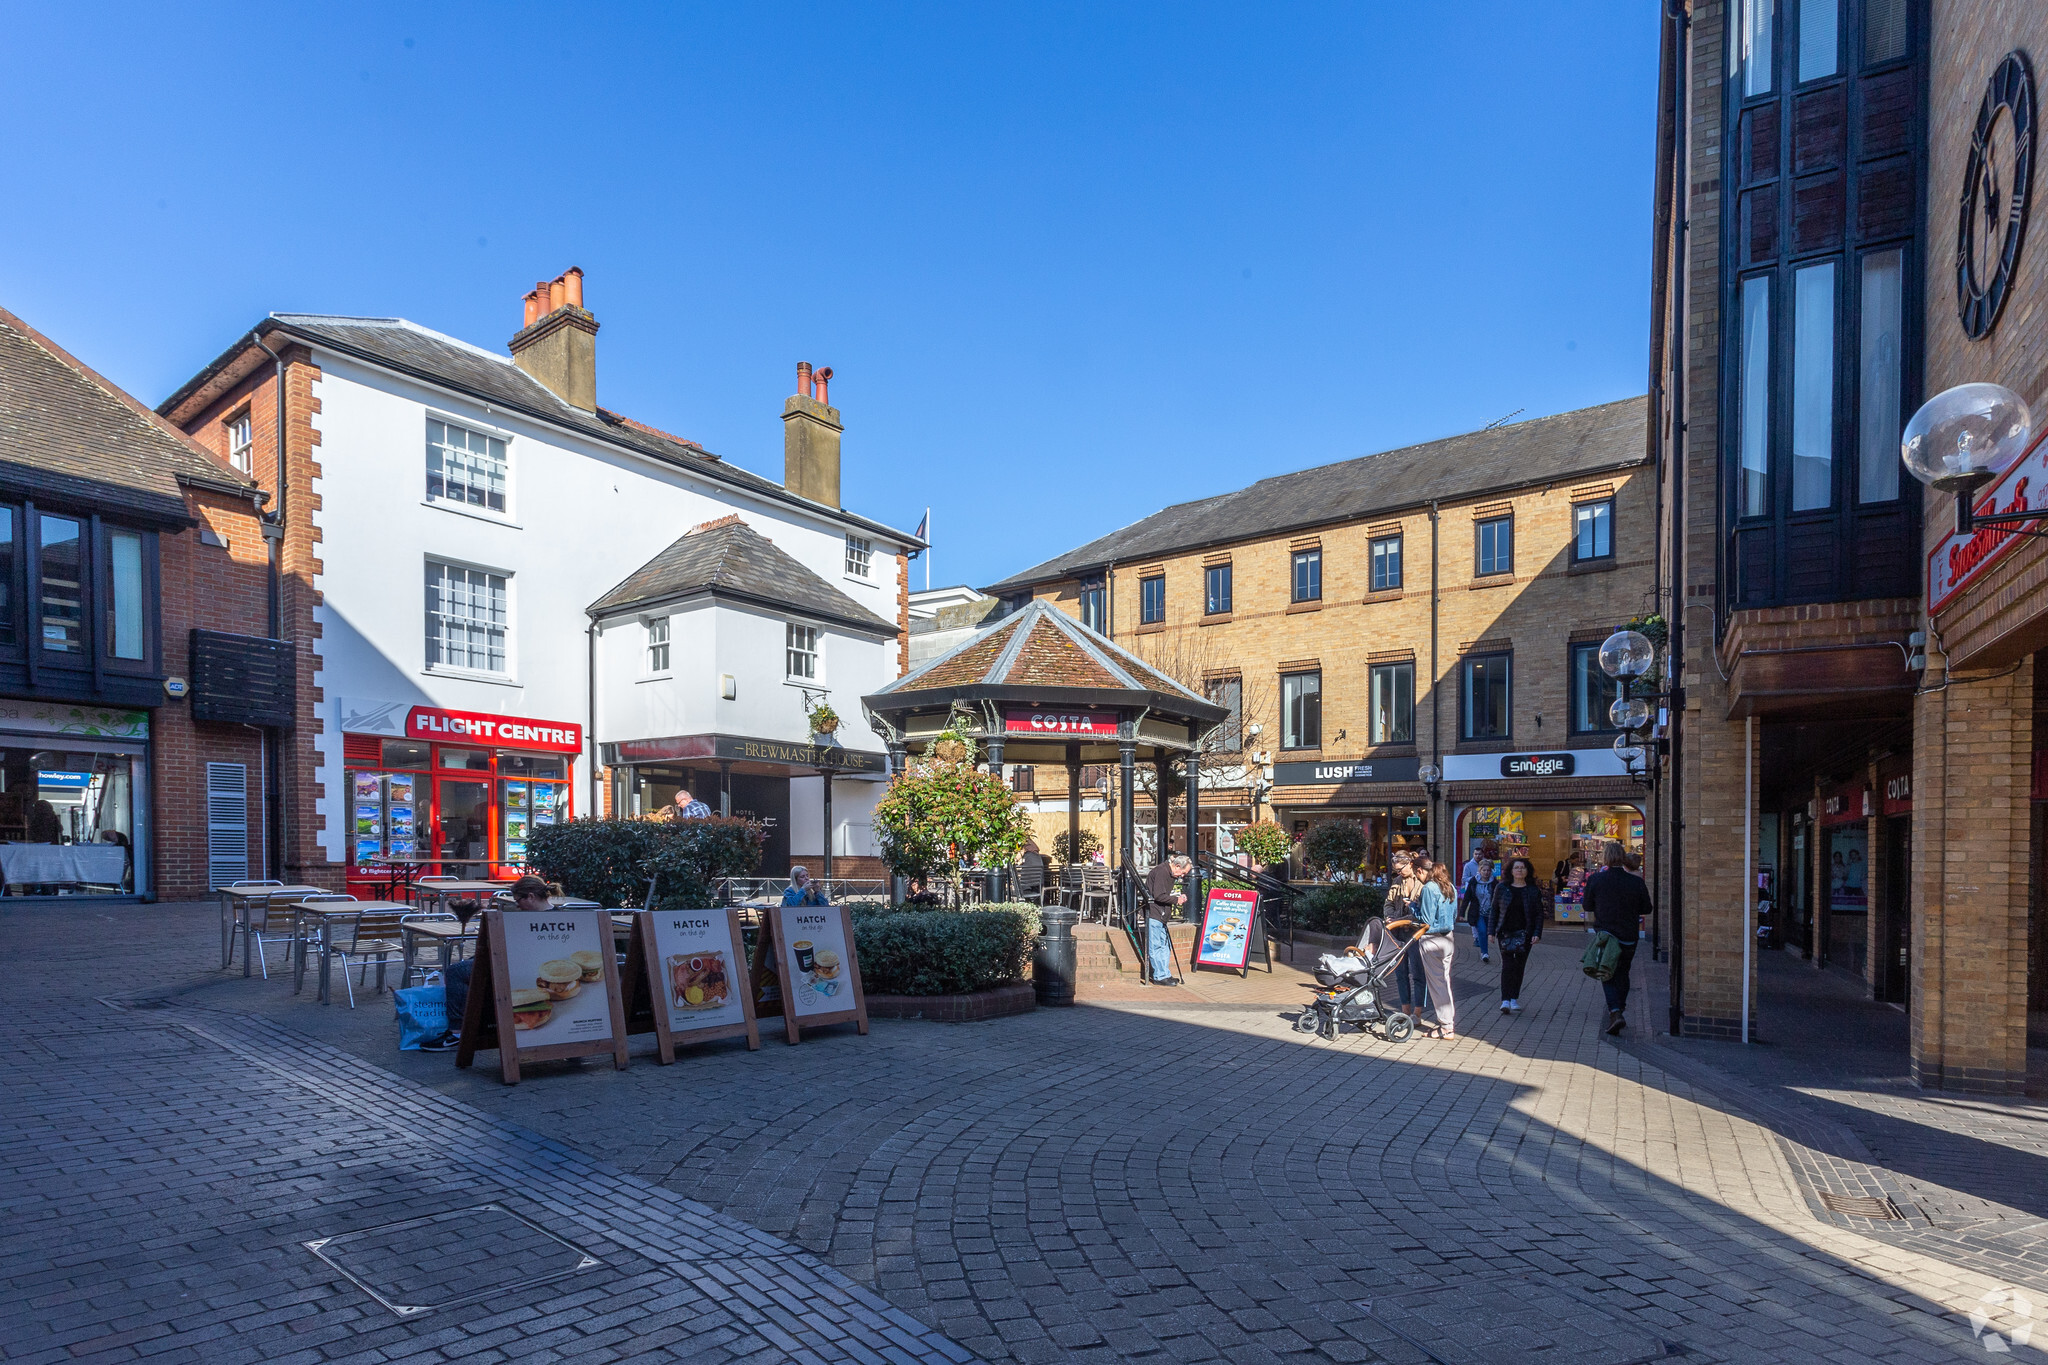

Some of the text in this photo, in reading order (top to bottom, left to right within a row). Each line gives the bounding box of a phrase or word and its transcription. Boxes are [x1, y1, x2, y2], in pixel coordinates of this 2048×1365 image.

[1031, 714, 1093, 731] COSTA
[416, 714, 576, 745] FLIGHT CENTRE
[745, 742, 865, 768] BREWMASTER HOUSE
[1315, 766, 1354, 779] LUSH
[1888, 776, 1909, 799] COSTA
[673, 919, 710, 929] HATCH
[796, 915, 827, 924] HATCH
[530, 922, 575, 932] HATCH
[548, 933, 560, 941] the
[561, 933, 570, 943] go
[415, 1009, 447, 1017] tradin
